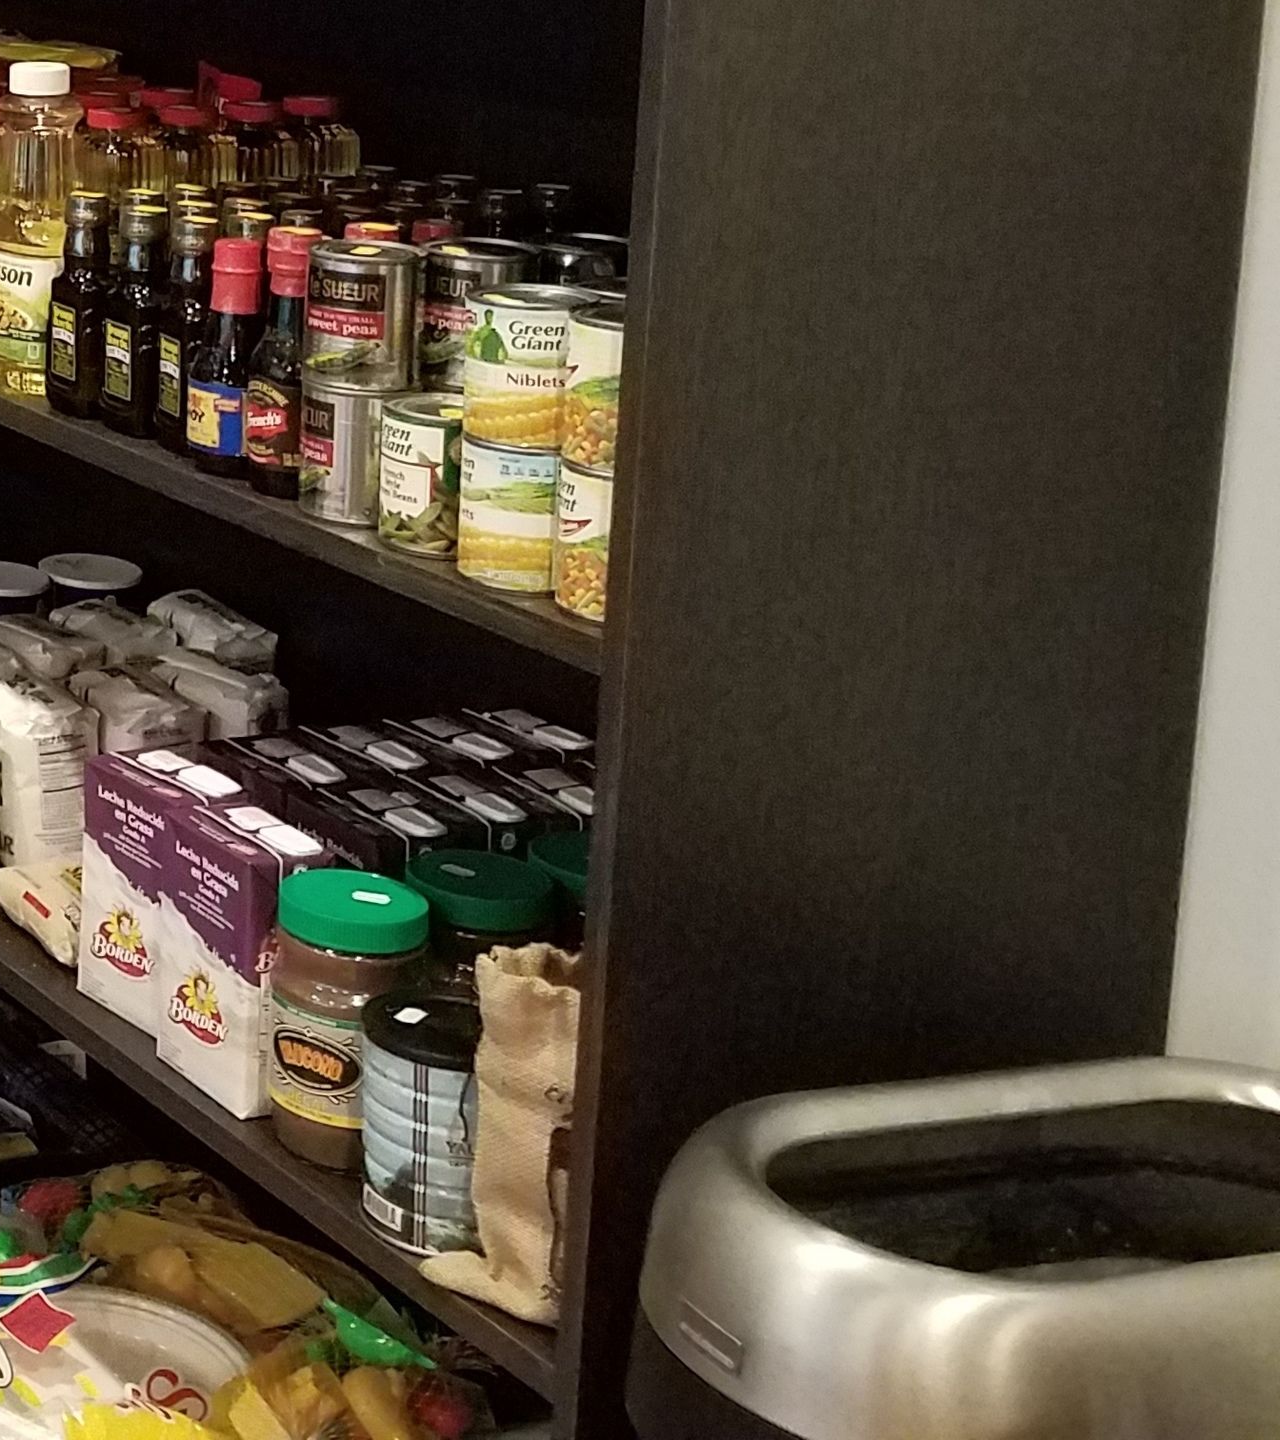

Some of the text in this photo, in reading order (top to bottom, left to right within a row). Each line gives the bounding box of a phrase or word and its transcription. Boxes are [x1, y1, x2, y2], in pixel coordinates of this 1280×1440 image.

[322, 278, 380, 303] SUEUR
[342, 323, 379, 337] peas
[509, 320, 566, 337] Green
[512, 335, 564, 353] Giant
[506, 371, 567, 389] Niblets
[97, 783, 126, 810] Leche
[114, 808, 155, 839] en Grasa
[175, 839, 202, 867] Leche
[190, 865, 228, 900] en Grasa
[90, 931, 155, 975] BORDEN
[168, 995, 229, 1042] BORDEN
